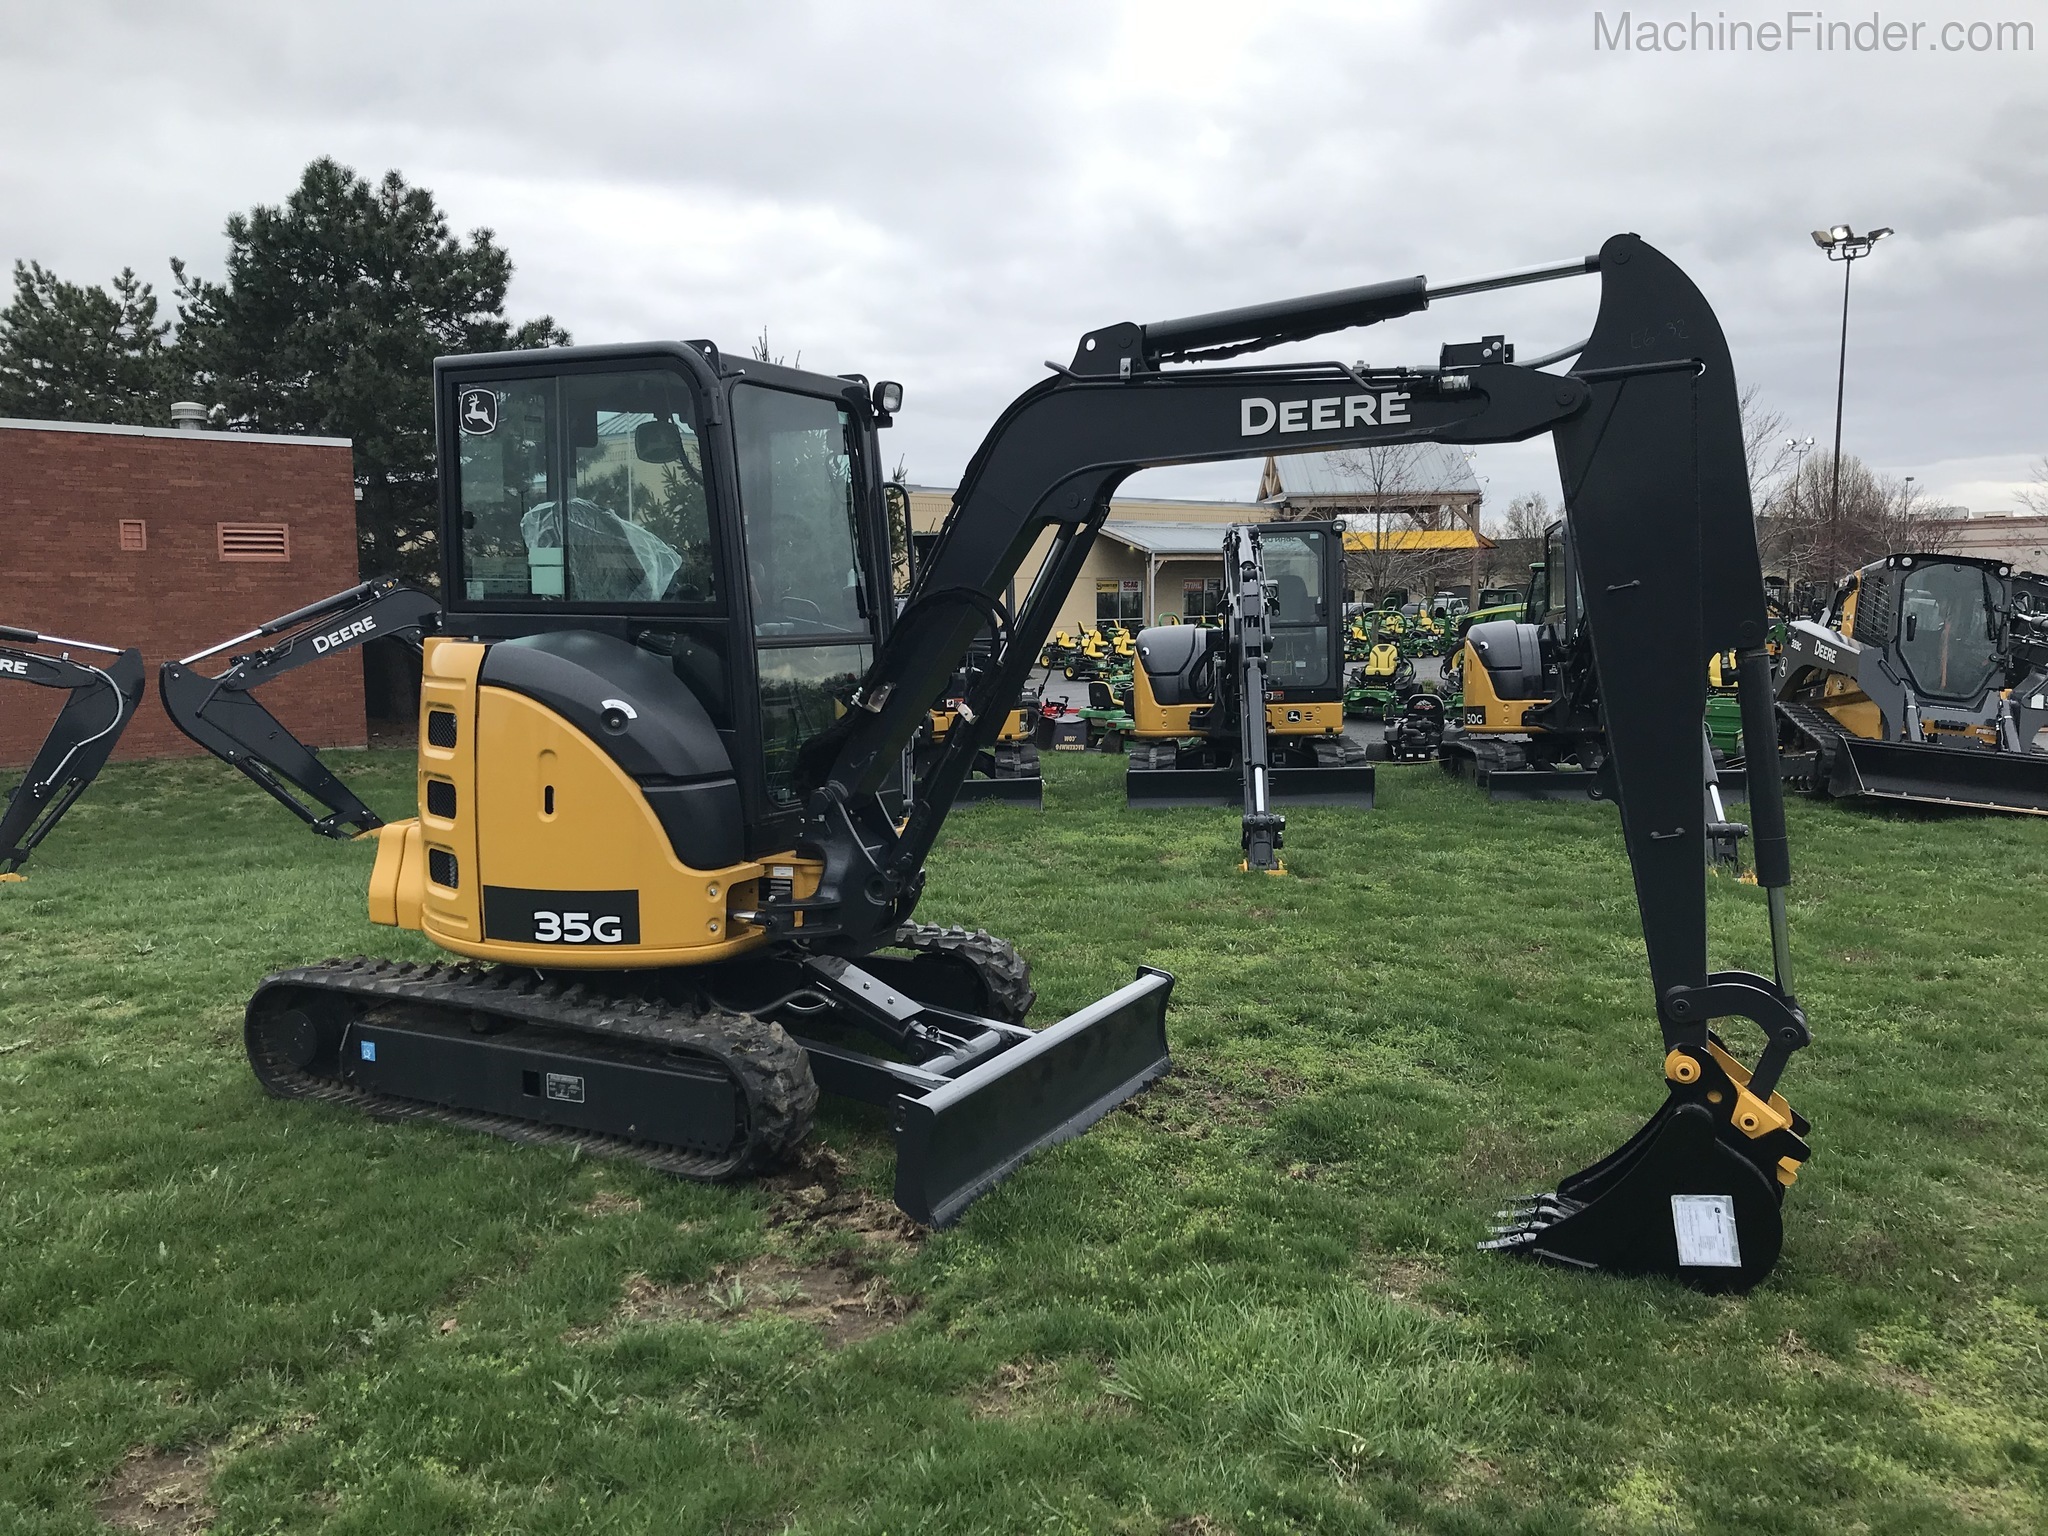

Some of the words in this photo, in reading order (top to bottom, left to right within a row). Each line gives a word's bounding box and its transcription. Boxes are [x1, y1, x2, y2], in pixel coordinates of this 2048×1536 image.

[1241, 391, 1411, 437] DEERE
[1184, 581, 1202, 589] STIHL
[312, 615, 377, 654] DEERE
[1814, 639, 1837, 664] DEERE
[1467, 713, 1483, 725] 50G
[533, 911, 623, 943] 35G
